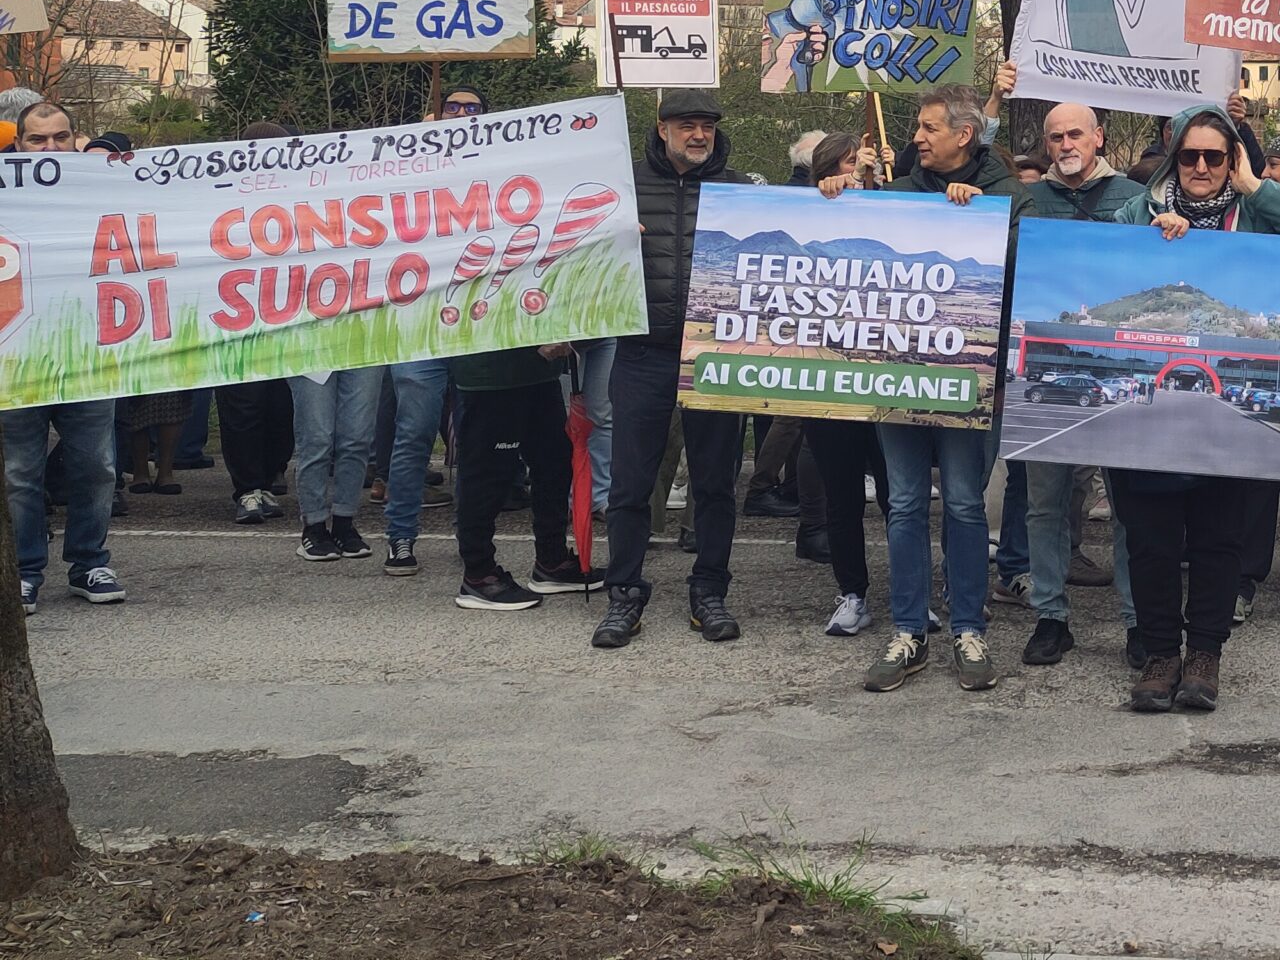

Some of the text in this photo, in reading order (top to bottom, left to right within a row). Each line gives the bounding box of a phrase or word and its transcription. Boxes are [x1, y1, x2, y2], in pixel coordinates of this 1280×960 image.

[344, 0, 504, 39] DE GAS
[621, 2, 697, 14] IL PAESAGGIO
[832, 30, 962, 84] COLLI
[1035, 49, 1203, 95] LASCIATECI RESPIRARE
[0, 113, 562, 188] TO Lasciateci respirare
[238, 156, 457, 194] SEZ. DI TORREGLIA
[89, 212, 179, 278] AL
[209, 174, 545, 261] CONSUMO
[735, 253, 956, 293] FERMIAMO
[96, 276, 172, 346] DI
[739, 284, 937, 323] L'ASSALTO
[714, 312, 965, 356] DI CEMENTO
[1123, 333, 1186, 344] EUROSPAR
[700, 362, 971, 402] AI COLLI EUGANEI
